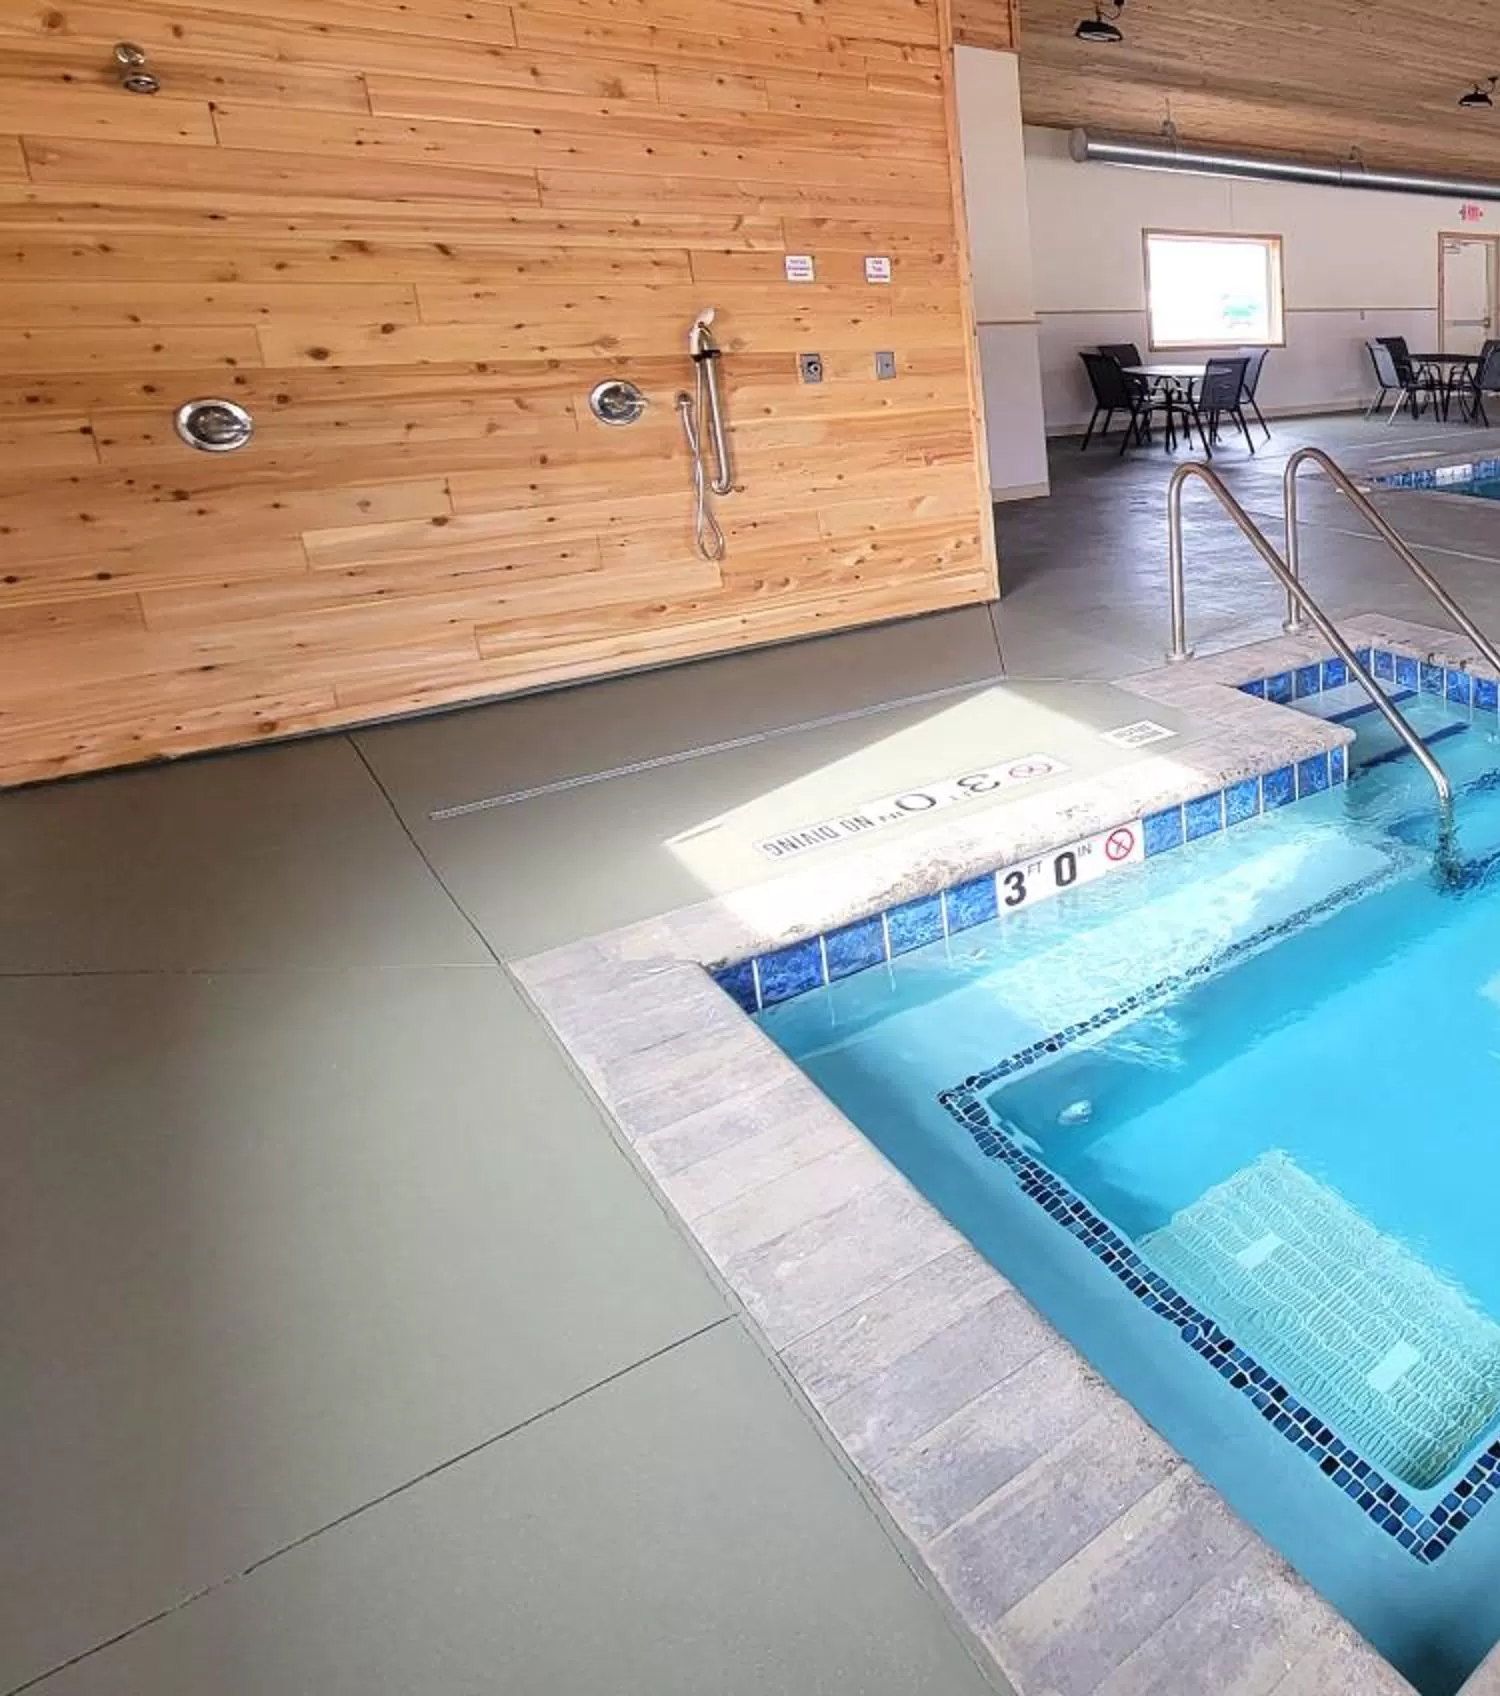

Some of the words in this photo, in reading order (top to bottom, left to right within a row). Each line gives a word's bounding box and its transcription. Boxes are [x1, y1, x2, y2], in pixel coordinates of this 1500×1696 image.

[957, 772, 1000, 793] 3
[894, 793, 938, 812] 0
[840, 814, 878, 835] NO
[762, 824, 839, 857] DIVING
[1003, 870, 1028, 906] 3
[1027, 860, 1042, 877] FT
[1053, 851, 1077, 887] 0
[1077, 843, 1092, 857] IN
